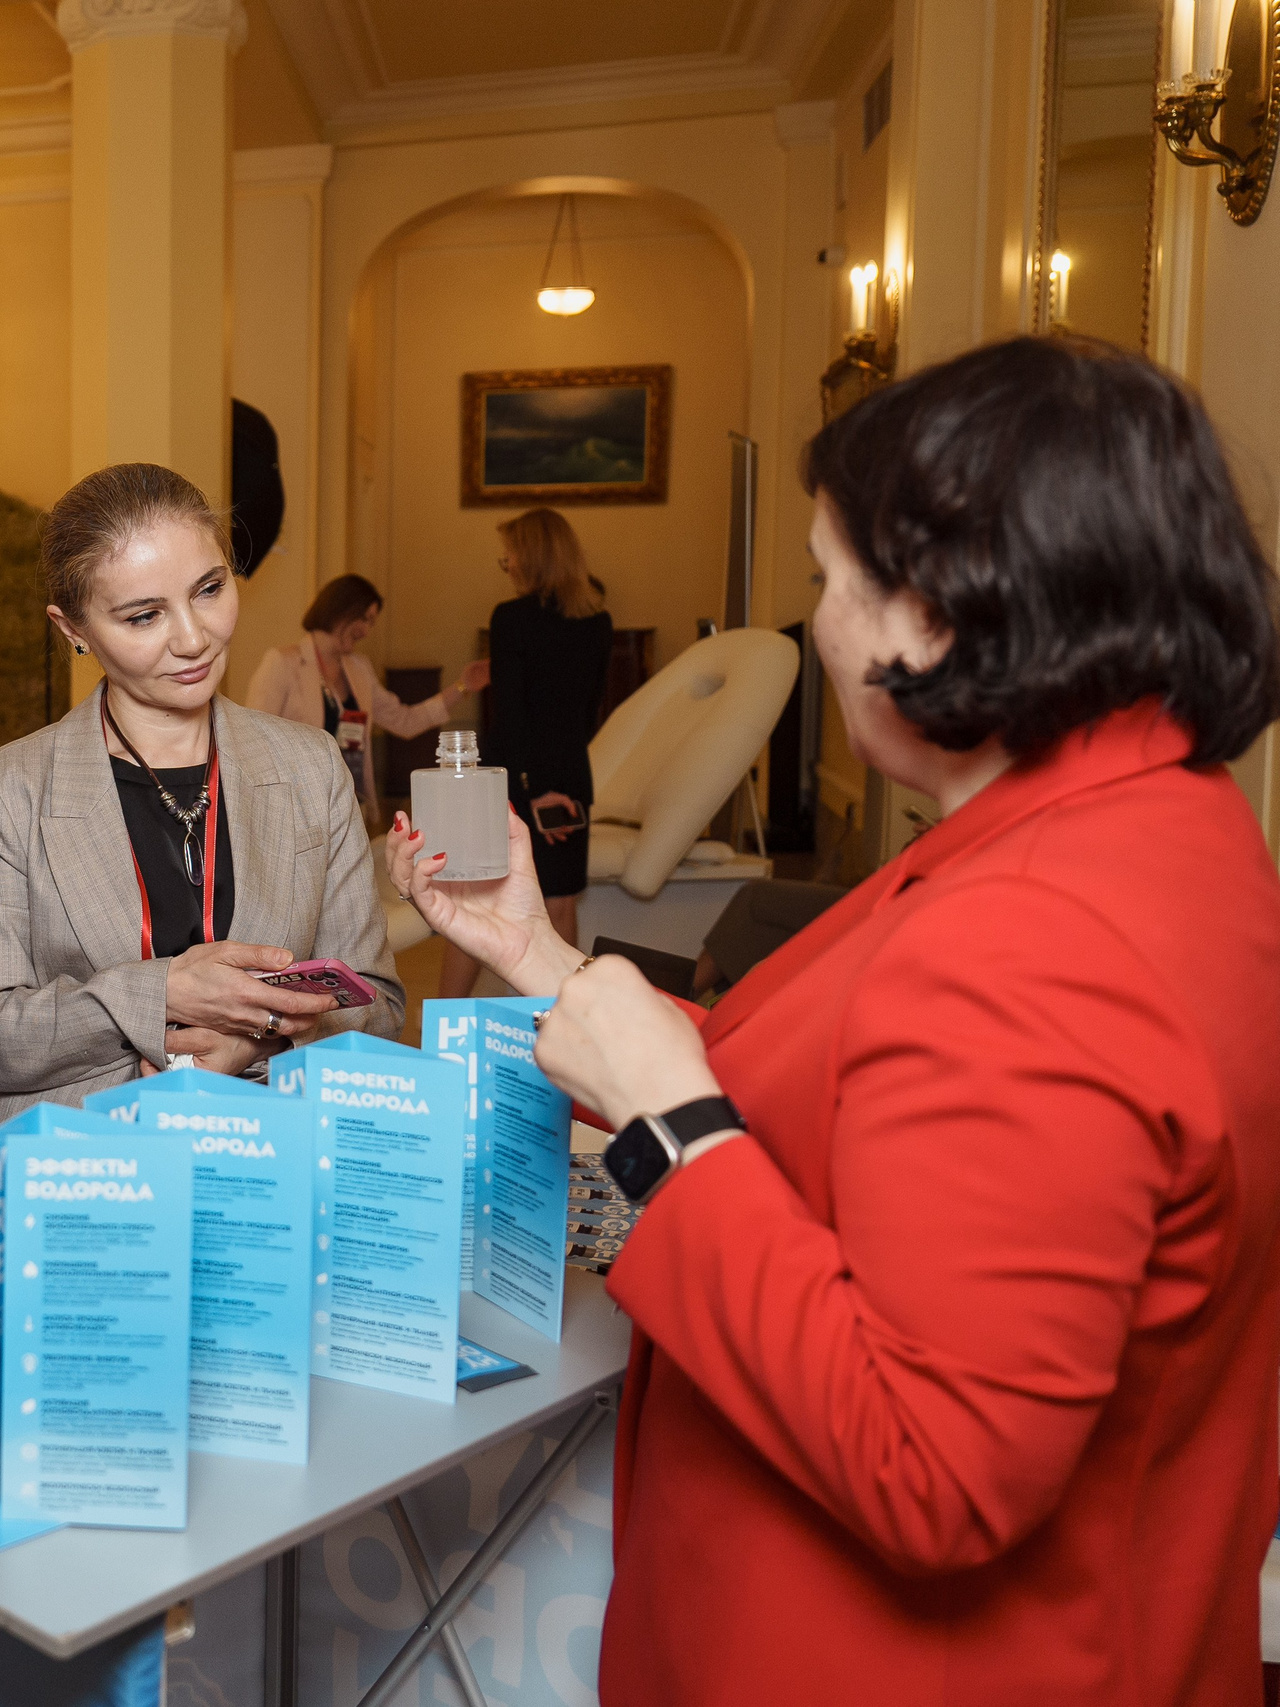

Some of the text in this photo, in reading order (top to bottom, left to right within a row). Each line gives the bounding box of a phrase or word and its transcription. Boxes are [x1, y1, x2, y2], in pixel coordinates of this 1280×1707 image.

[265, 973, 302, 986] WAS
[485, 1036, 536, 1065] ВОДОРО
[321, 1067, 416, 1093] ЭФФЕКТЫ
[320, 1087, 430, 1115] ВОДОРОДА
[156, 1111, 261, 1136] ЭФФЕКТЫ
[193, 1136, 277, 1159] ОРОДА
[24, 1157, 138, 1178] ЭФФЕКТЫ
[24, 1180, 154, 1203] ВОДОРОДА
